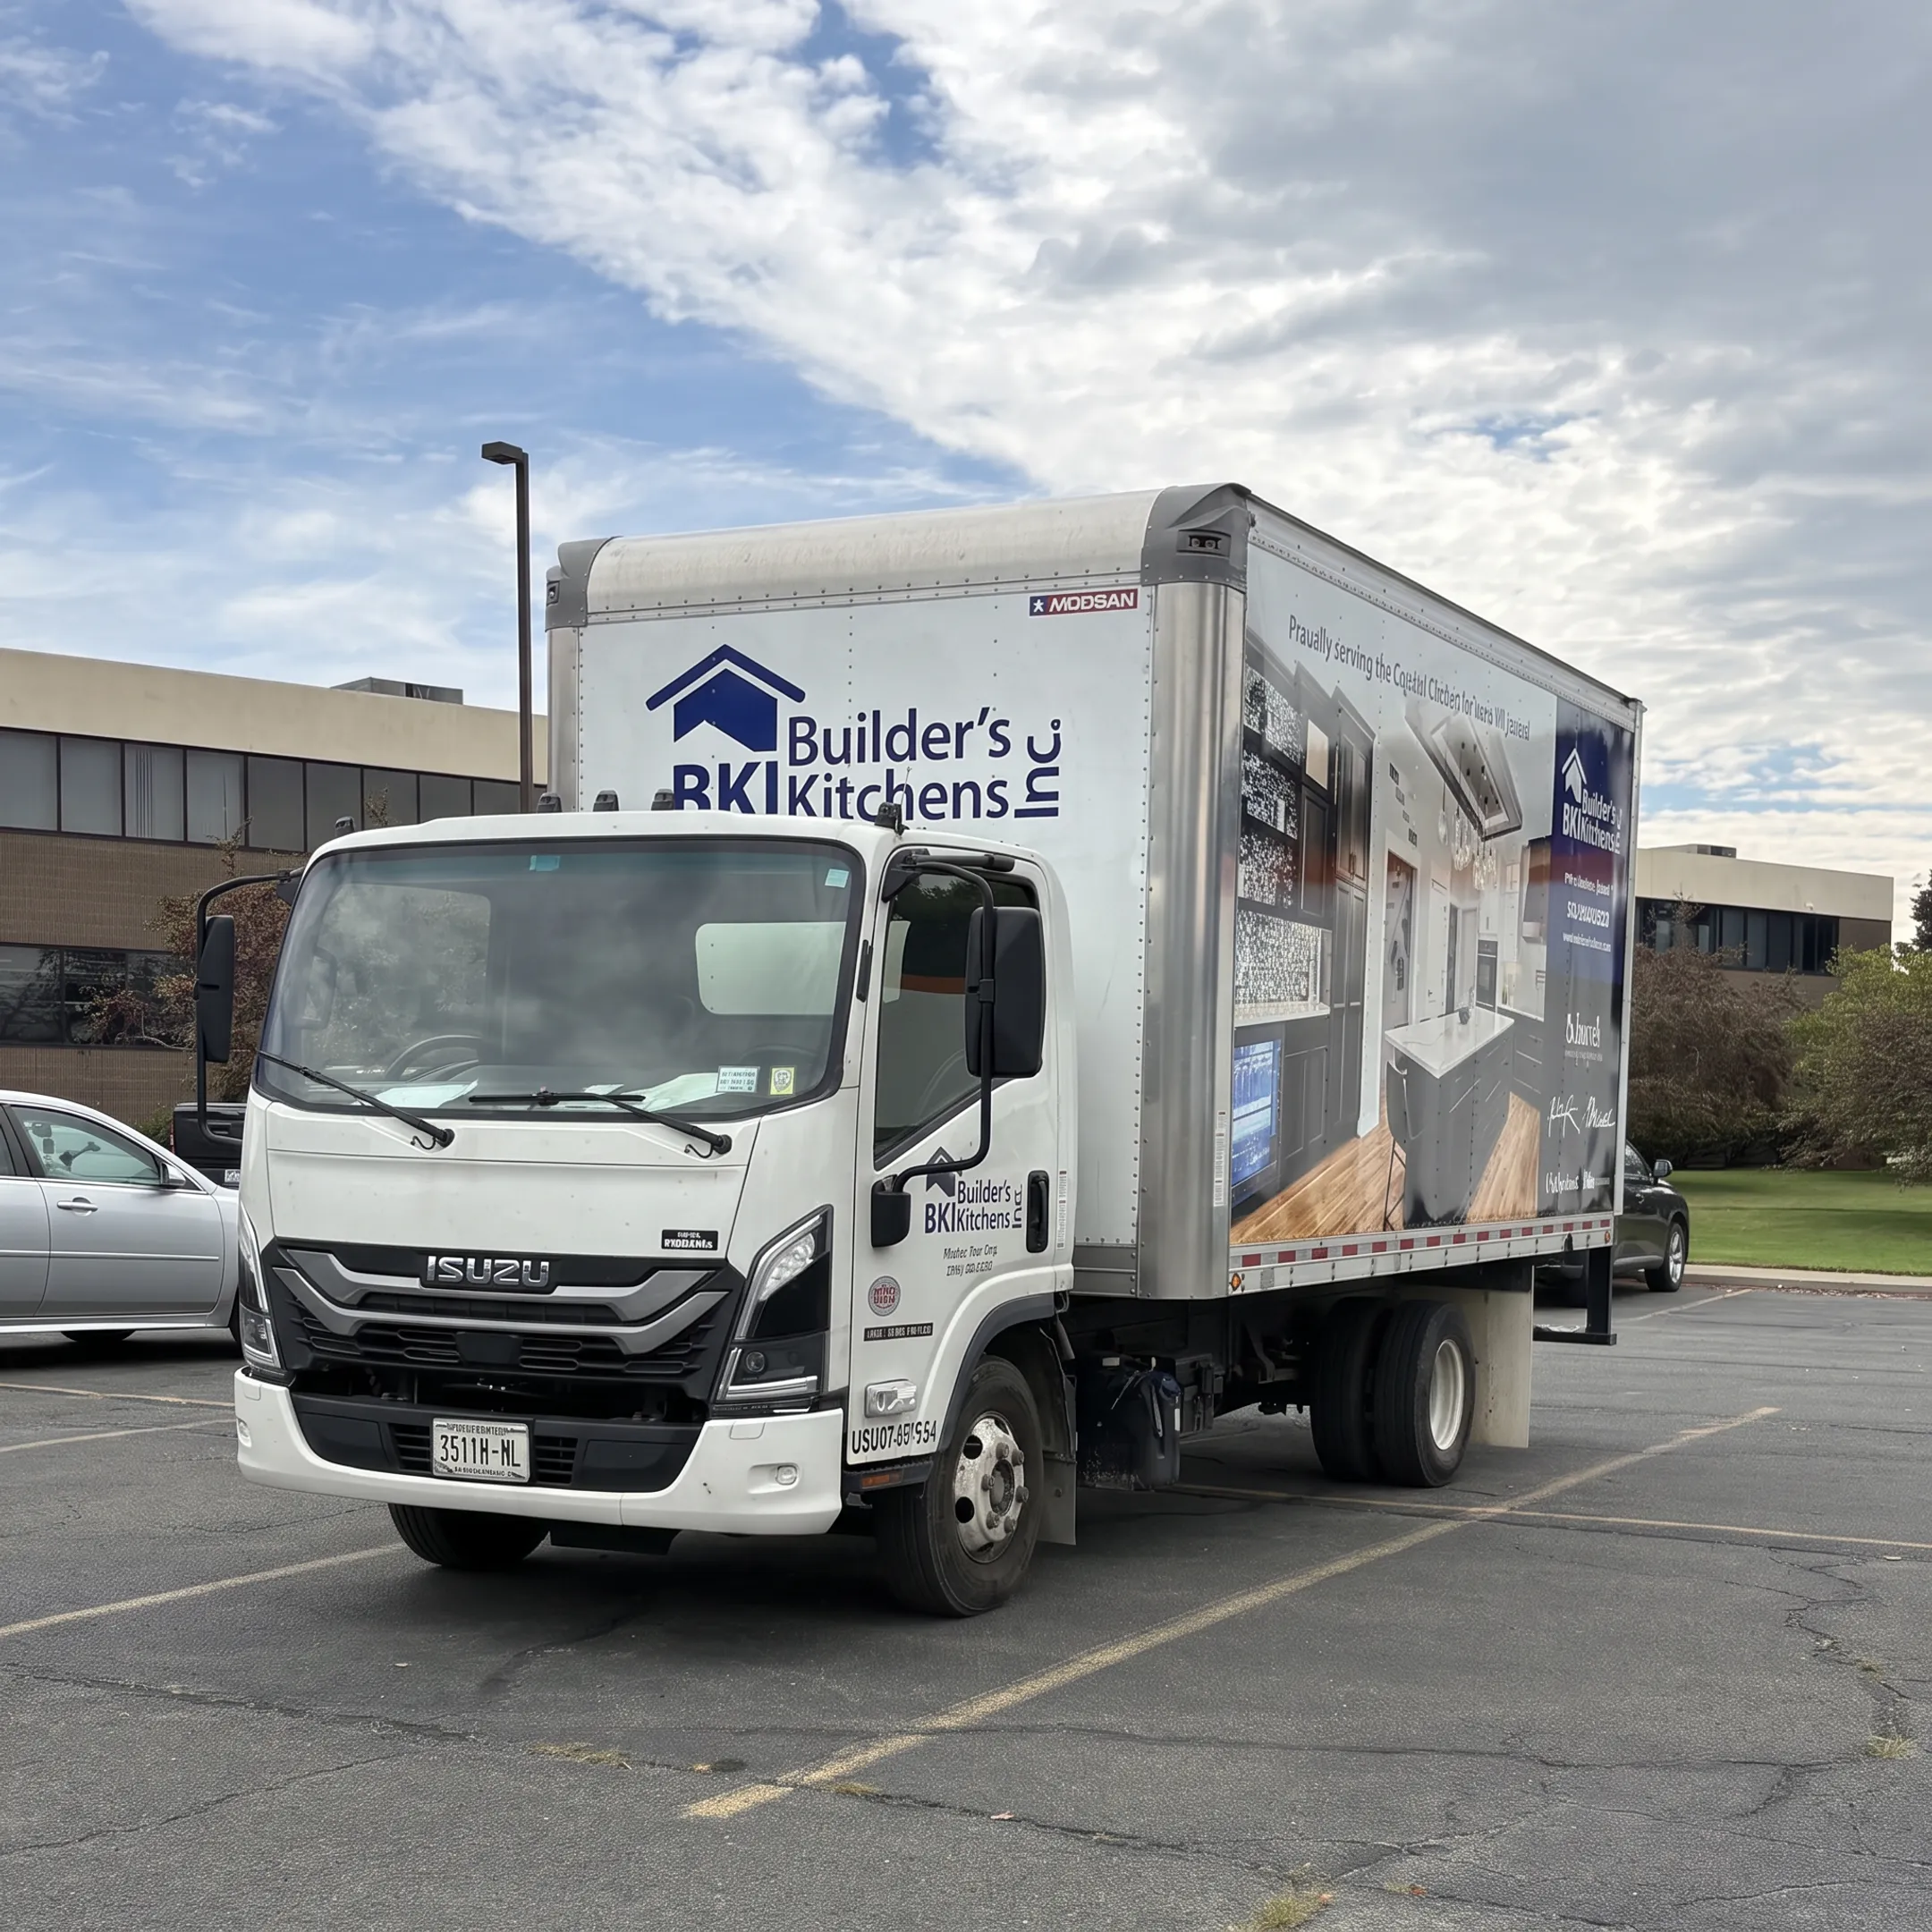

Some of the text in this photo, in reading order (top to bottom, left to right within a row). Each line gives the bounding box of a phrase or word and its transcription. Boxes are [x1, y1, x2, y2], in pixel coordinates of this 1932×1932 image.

[1335, 641, 1373, 681] serving
[1376, 652, 1392, 683] the
[789, 707, 1012, 767] Builder's
[788, 768, 1010, 821] Kitchens
[1562, 802, 1581, 840] BKI
[958, 1179, 1011, 1204] Builder's
[925, 1202, 1011, 1233] BKI Kitchens
[426, 1255, 549, 1286] ISUZU
[440, 1435, 521, 1468] 3511H-NL
